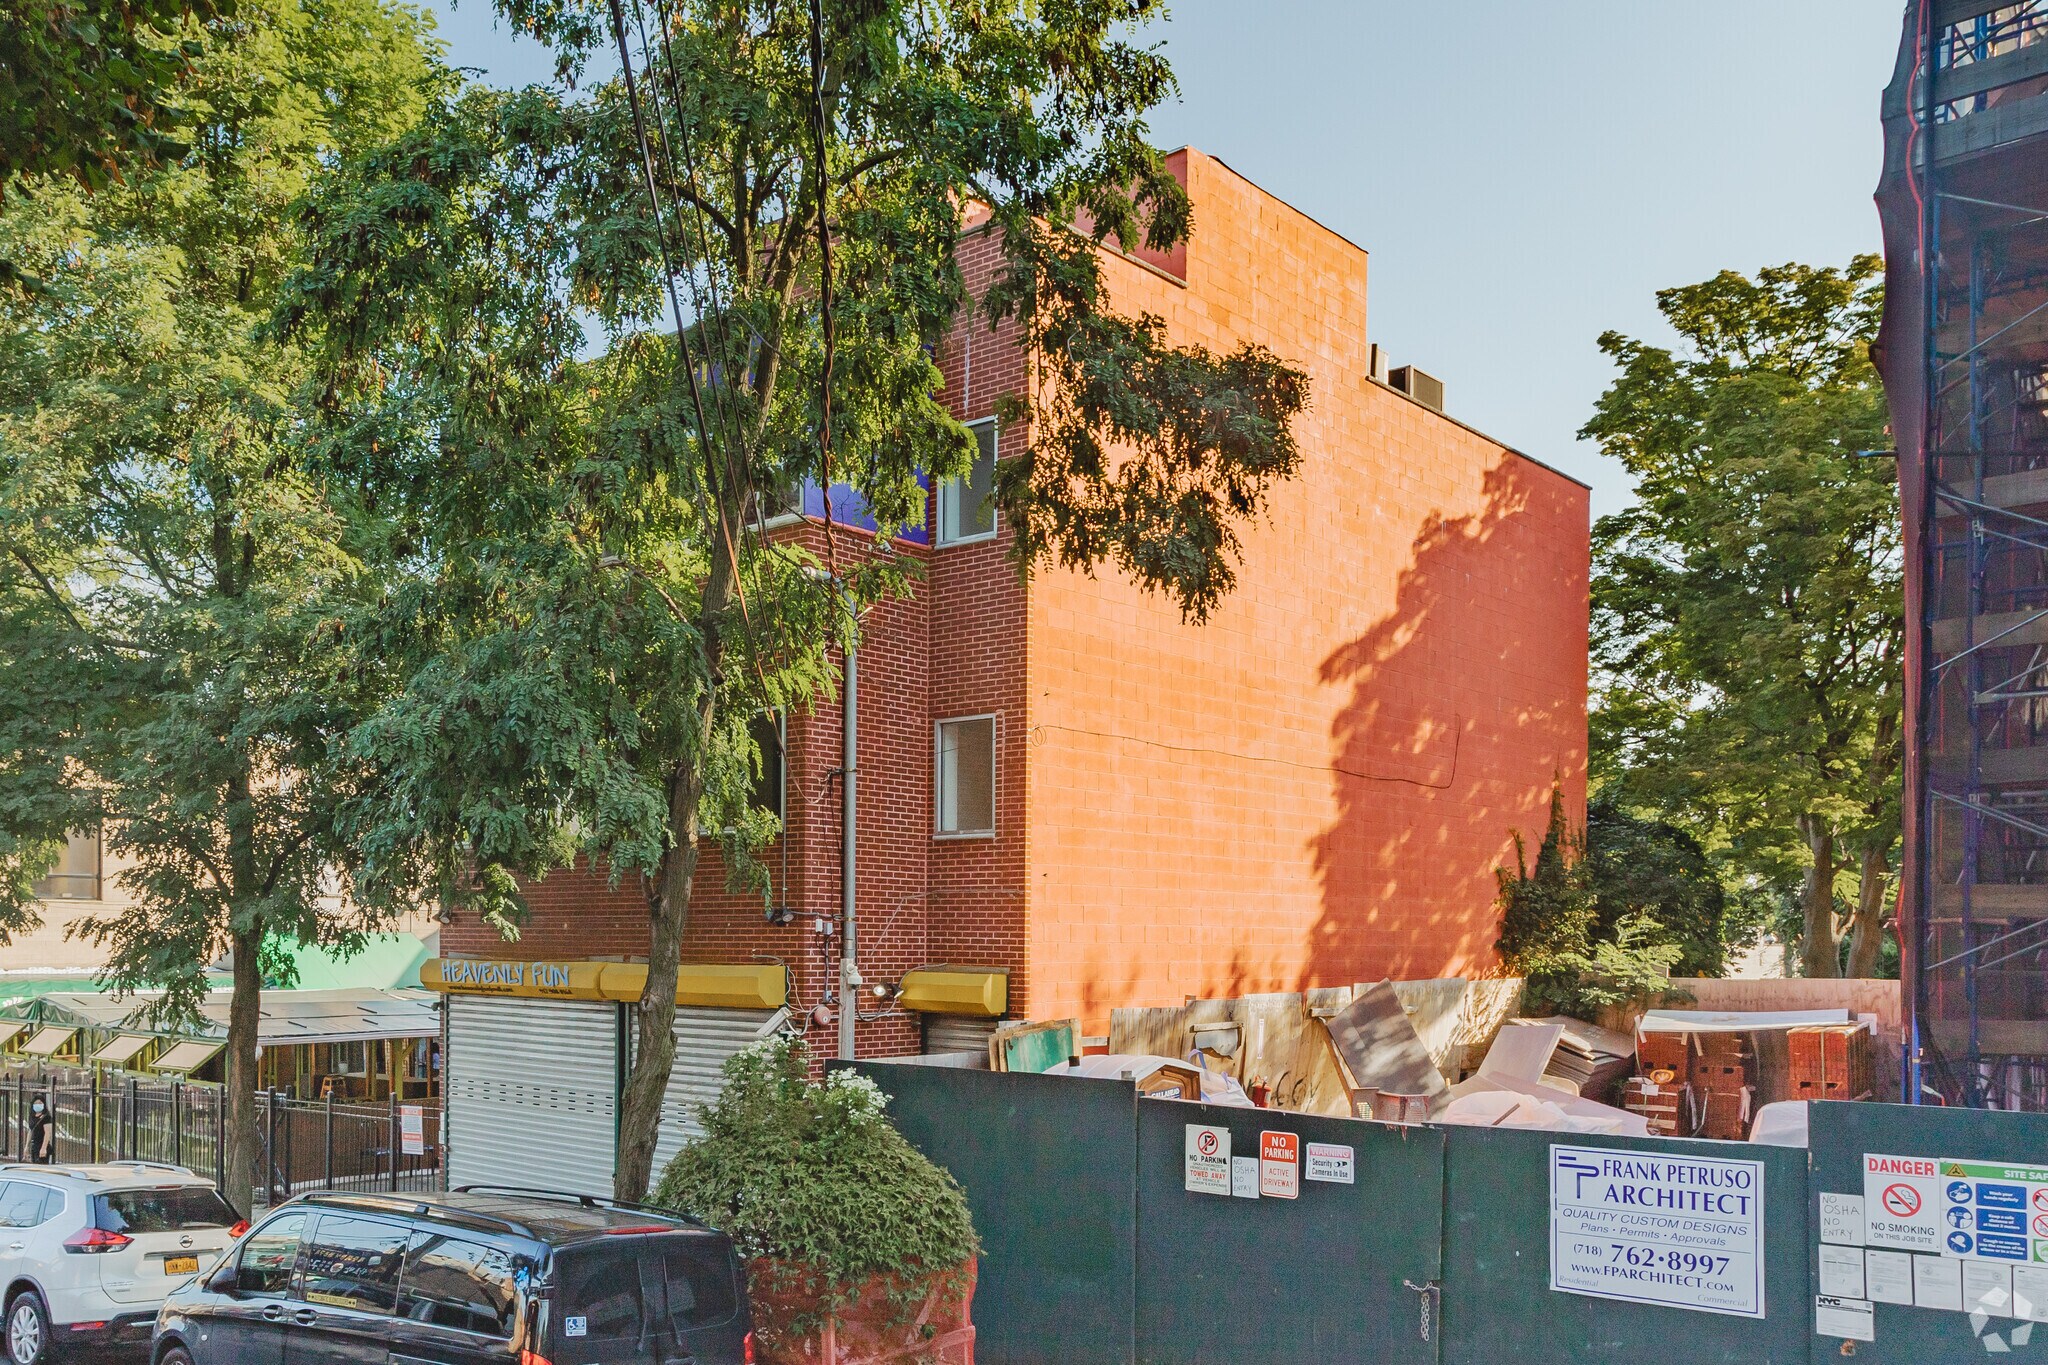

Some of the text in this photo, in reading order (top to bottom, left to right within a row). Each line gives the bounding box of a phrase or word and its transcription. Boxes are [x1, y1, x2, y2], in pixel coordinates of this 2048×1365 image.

[441, 960, 569, 987] HEAVENLY FUN
[1271, 1136, 1287, 1147] NO
[1264, 1147, 1294, 1160] PARKING
[1310, 1146, 1350, 1158] WARNING
[1189, 1154, 1198, 1162] NO
[1312, 1158, 1332, 1168] Security
[1234, 1166, 1255, 1174] OSHA
[1312, 1168, 1332, 1176] Cameras
[1867, 1157, 1935, 1176] DANGER
[1190, 1170, 1226, 1180] TOWED AWAY
[1268, 1168, 1289, 1177] ACTIVE
[1603, 1159, 1751, 1189] FRANK PETRUSO
[2003, 1169, 2026, 1179] SITE
[1264, 1178, 1294, 1188] DRIVEWAY
[1603, 1183, 1752, 1216] ARCHITECT
[1822, 1195, 1837, 1203] NO
[1824, 1204, 1860, 1215] OSHA
[1562, 1207, 1748, 1236] QUALITY CUSTOM DESIGNS
[1824, 1217, 1840, 1226] NO
[1823, 1228, 1853, 1240] ENTRY
[1871, 1221, 1935, 1236] NO SMOKING
[1580, 1223, 1726, 1247] Plans Permits Approvals
[1917, 1236, 1932, 1244] SITE
[1573, 1243, 1602, 1257] (718)
[1558, 1275, 1599, 1288] Residential
[1697, 1294, 1749, 1307] Commercial
[1818, 1296, 1841, 1306] NYC
